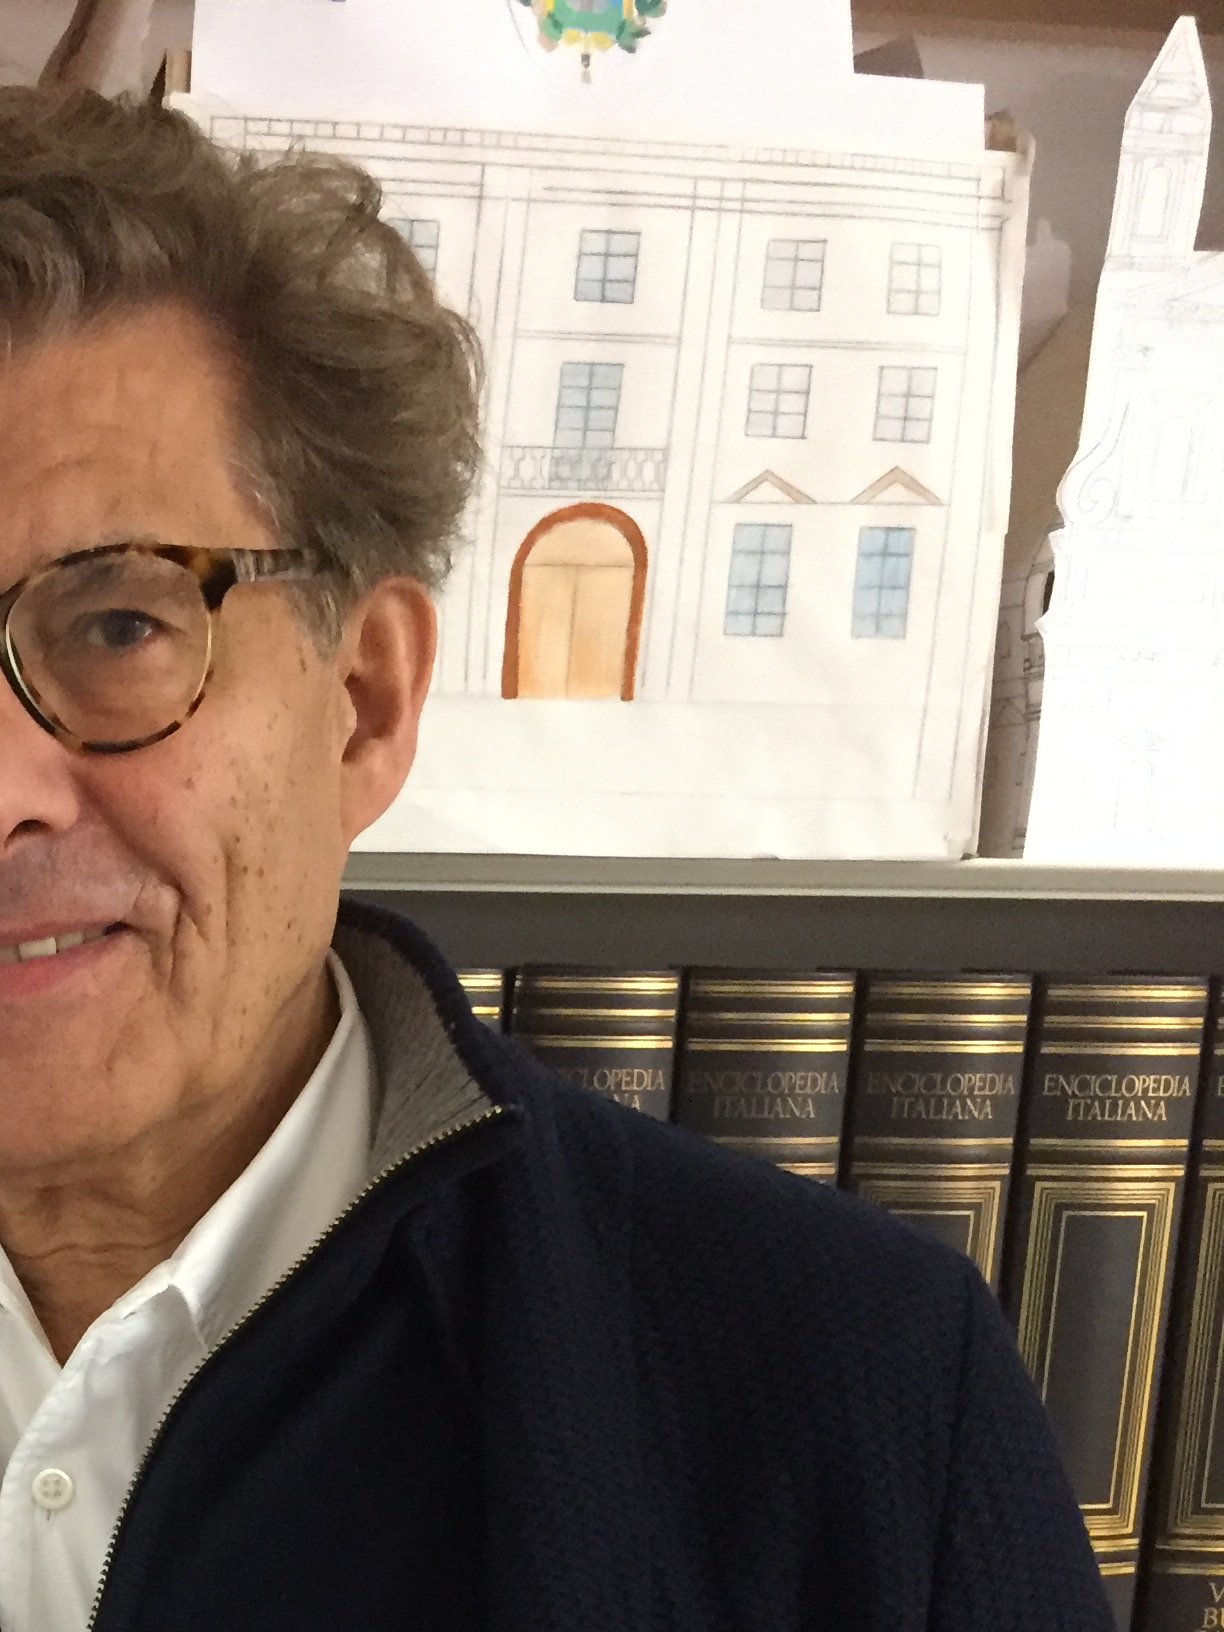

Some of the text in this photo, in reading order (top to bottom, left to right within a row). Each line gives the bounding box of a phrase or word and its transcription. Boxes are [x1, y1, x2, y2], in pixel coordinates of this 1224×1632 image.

[687, 1071, 840, 1094] ENCICLOPEDIA
[867, 1072, 1015, 1096] ENCICLOPEDIA
[1043, 1073, 1192, 1097] ENCICLOPEDIA
[712, 1096, 816, 1119] ITALIANA
[890, 1097, 994, 1121] ITALIANA
[1066, 1099, 1168, 1122] ITALIANA
